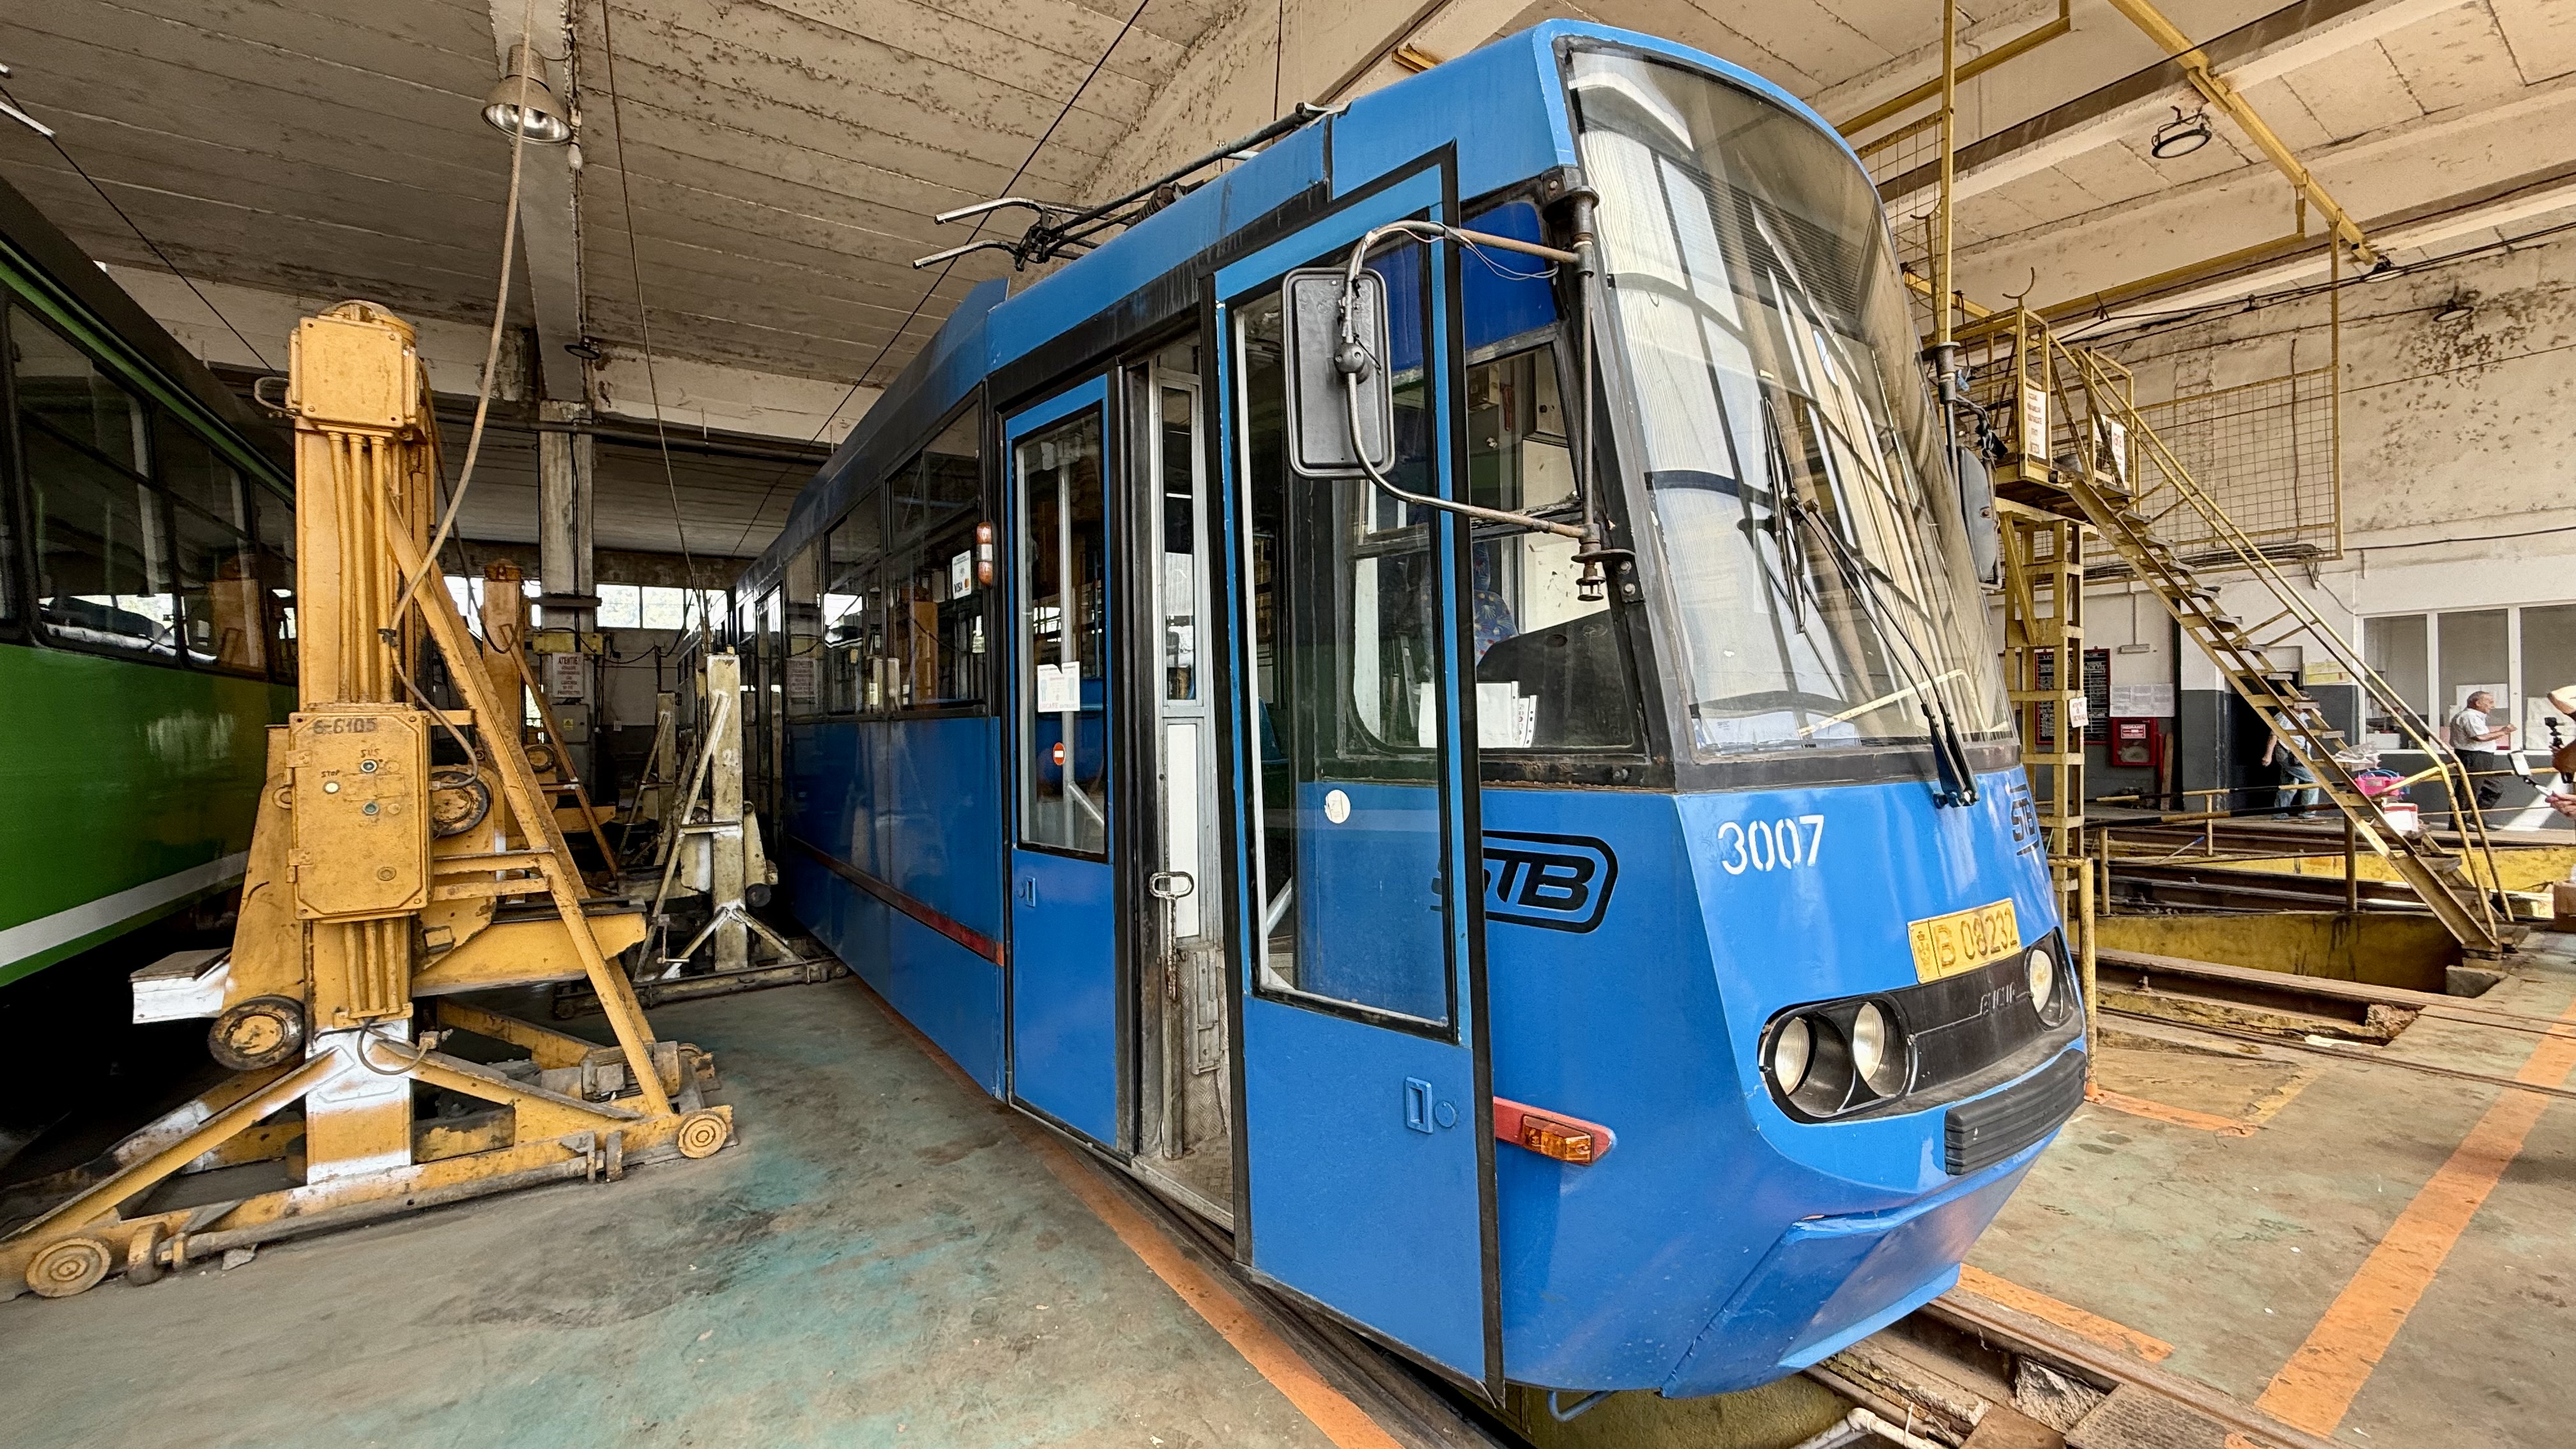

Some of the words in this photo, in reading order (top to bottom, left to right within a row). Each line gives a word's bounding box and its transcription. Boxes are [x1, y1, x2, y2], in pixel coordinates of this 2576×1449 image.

[1717, 815, 1825, 875] 3007
[1935, 924, 1957, 969] B
[1960, 907, 2018, 960] 08232
